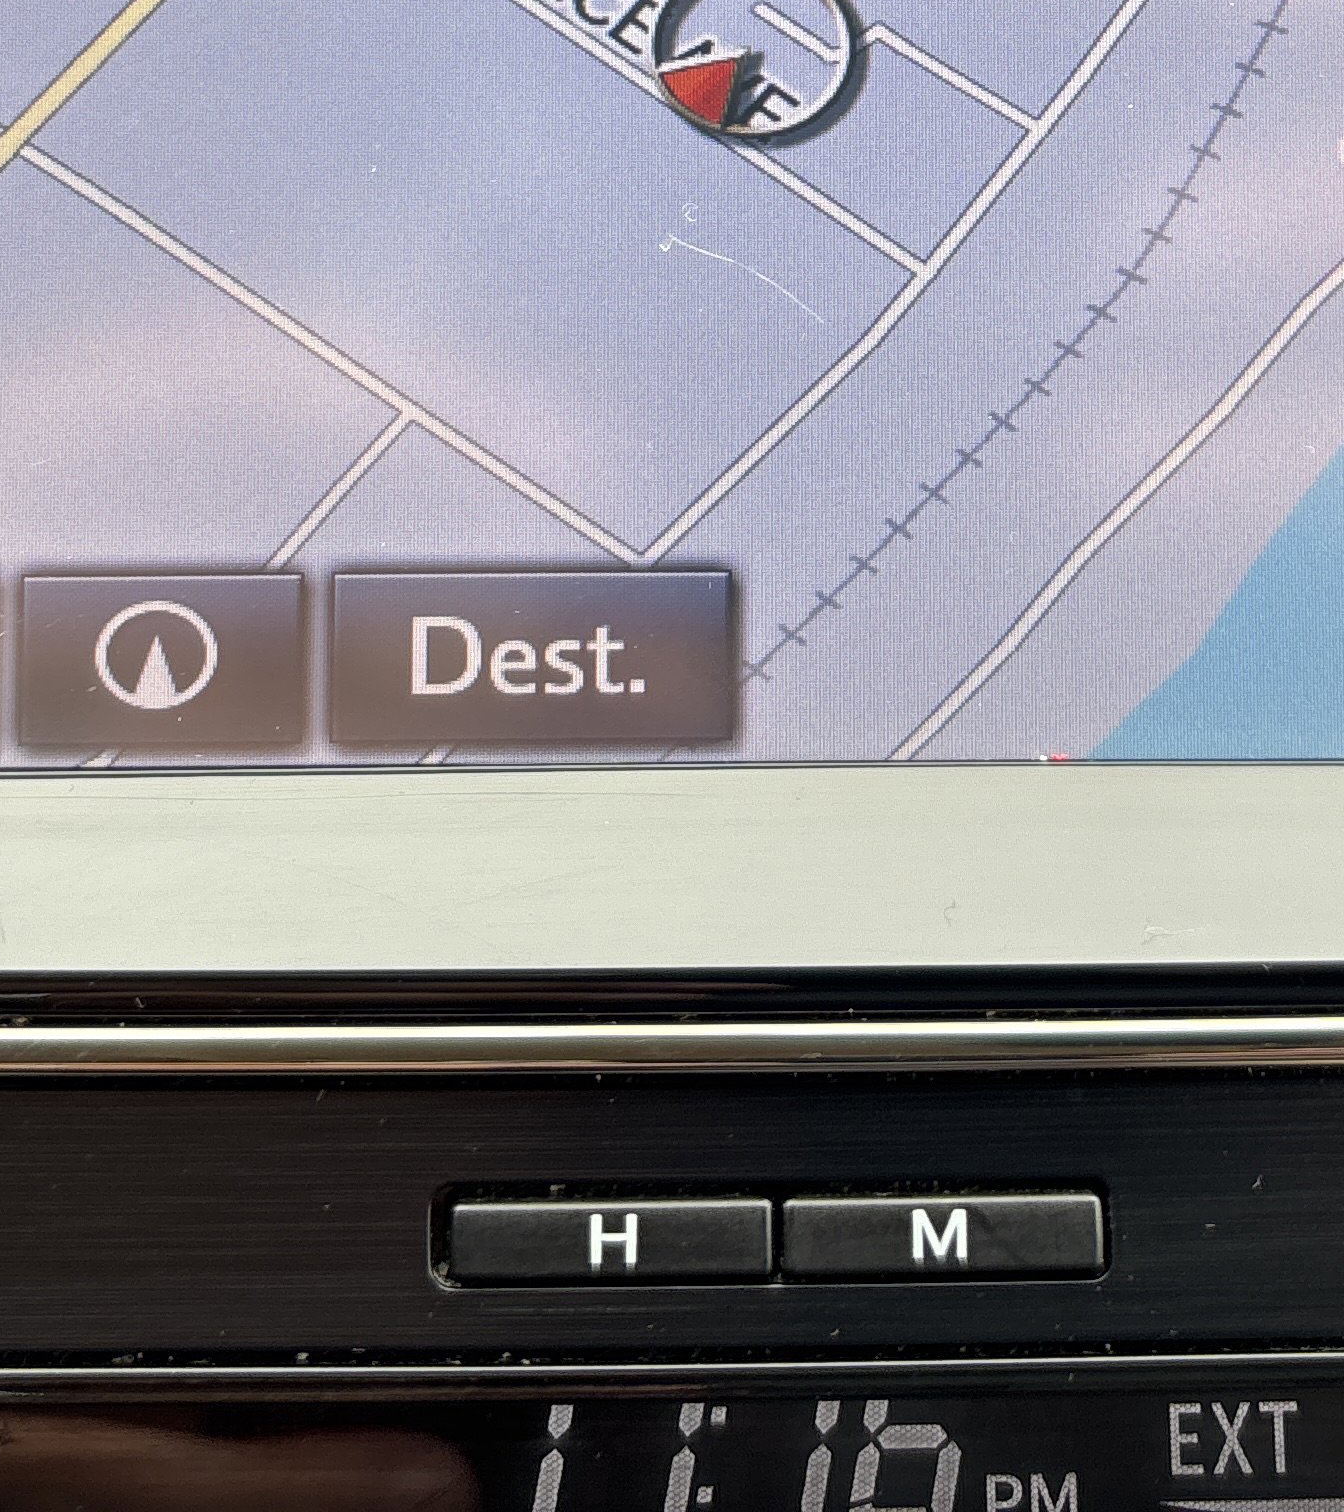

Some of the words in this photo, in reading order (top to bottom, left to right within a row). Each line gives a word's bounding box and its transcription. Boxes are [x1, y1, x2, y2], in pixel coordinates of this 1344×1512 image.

[410, 616, 647, 698] Dest.
[587, 1212, 639, 1271] H
[910, 1206, 968, 1265] M
[1169, 1400, 1298, 1476] EXT
